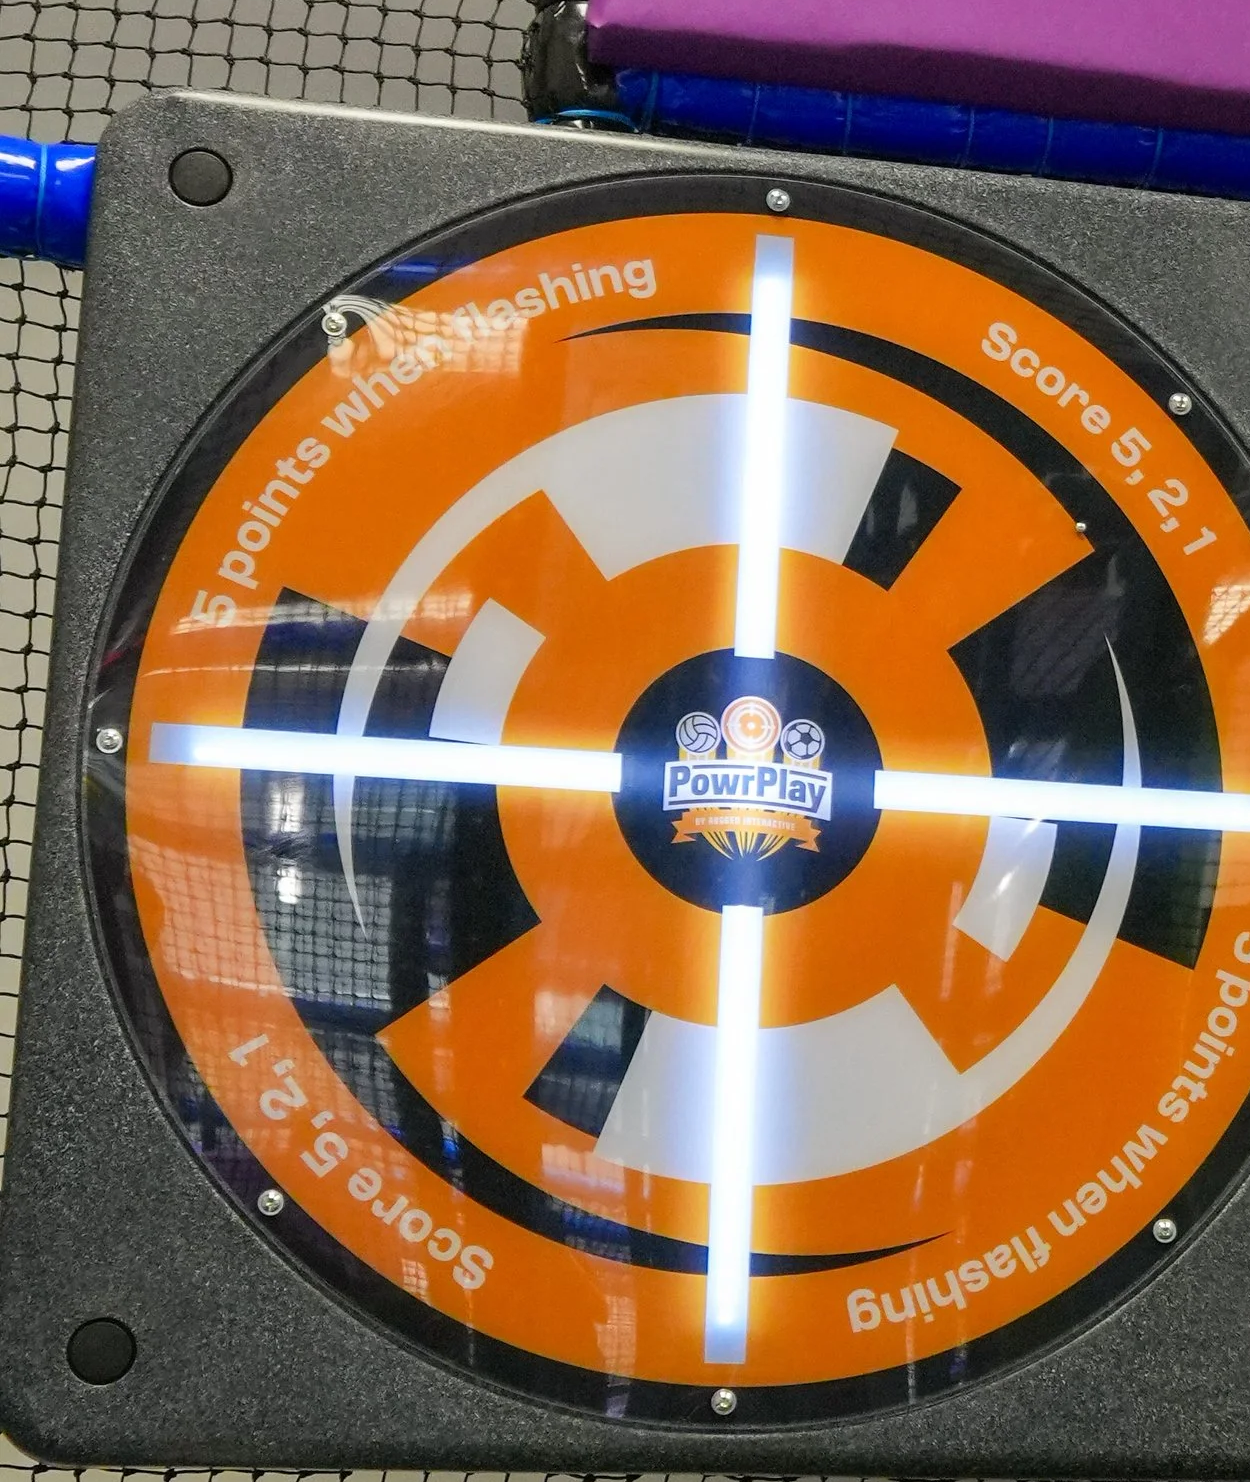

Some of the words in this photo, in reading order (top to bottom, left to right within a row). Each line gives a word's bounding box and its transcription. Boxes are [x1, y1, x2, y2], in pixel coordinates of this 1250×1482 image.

[189, 589, 236, 628] 5
[218, 435, 331, 591] points
[320, 331, 454, 439] when
[450, 257, 657, 346] flashing
[981, 322, 1111, 434] Score
[1111, 426, 1152, 486] 5,
[1147, 478, 1189, 533] 2,
[1182, 526, 1217, 556] 1
[668, 765, 827, 814] PowrPlay
[228, 1033, 270, 1067] 1
[259, 1058, 309, 1121] 2,
[300, 1110, 349, 1178] 5,
[1047, 1124, 1169, 1238] when
[347, 1167, 494, 1290] Score
[846, 1224, 1053, 1334] flashing
